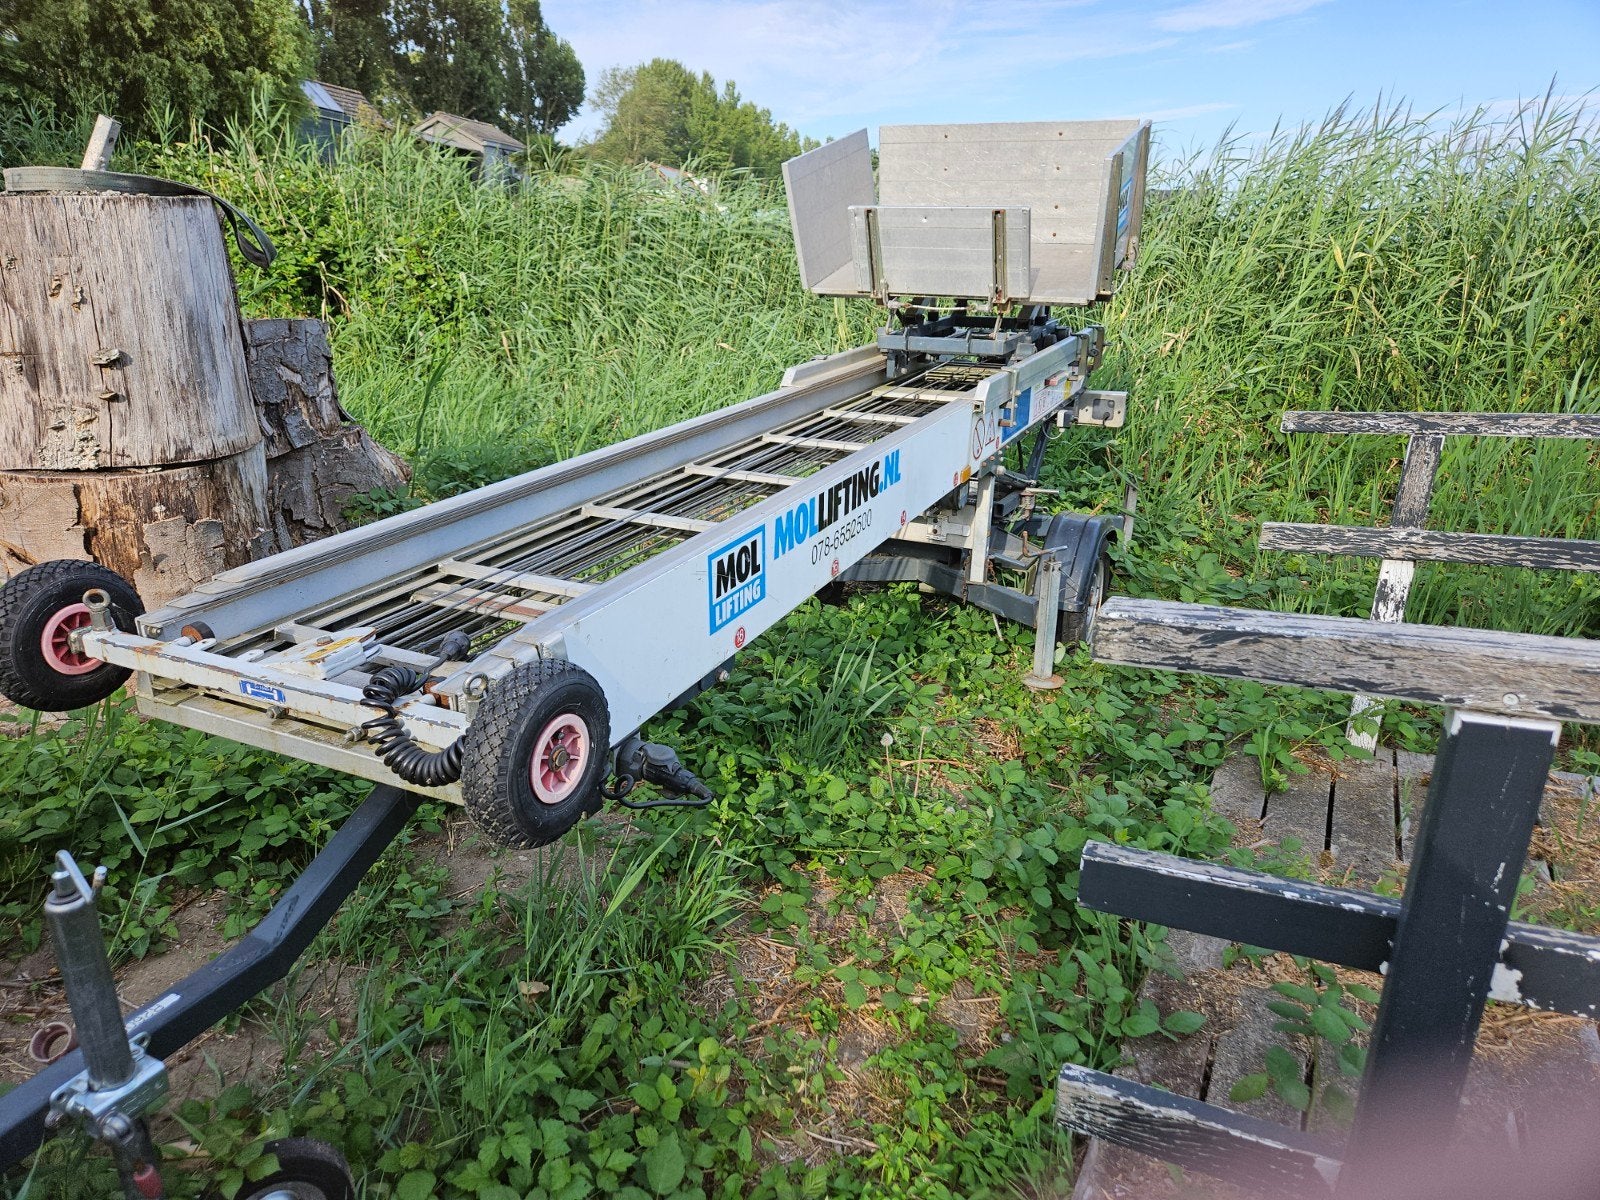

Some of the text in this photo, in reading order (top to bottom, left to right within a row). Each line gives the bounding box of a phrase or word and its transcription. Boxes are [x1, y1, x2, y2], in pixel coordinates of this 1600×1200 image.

[774, 449, 901, 560] MOLLIFTING.NL
[811, 509, 872, 565] 078-6552500
[716, 539, 761, 599] MOL
[715, 578, 761, 627] LIFTING
